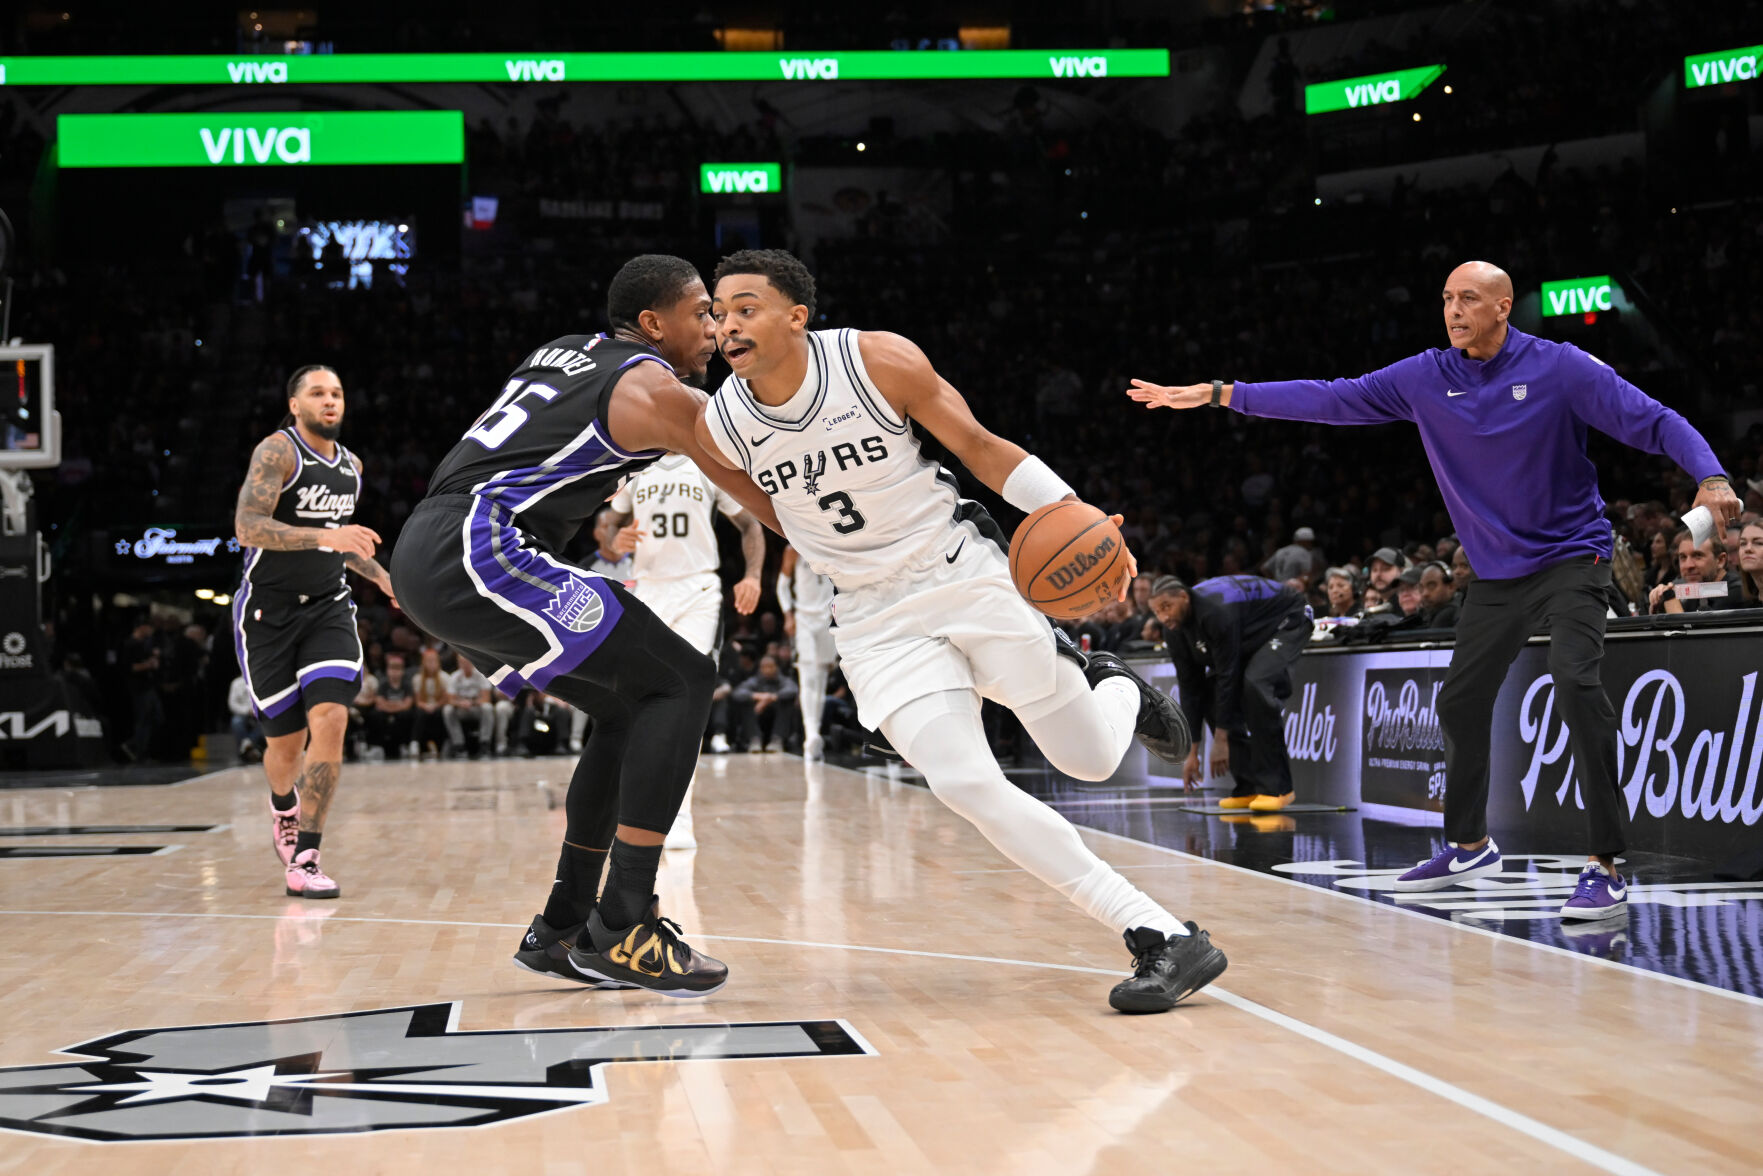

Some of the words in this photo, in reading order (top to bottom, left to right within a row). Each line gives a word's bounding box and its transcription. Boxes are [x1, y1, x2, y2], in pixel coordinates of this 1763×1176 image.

[227, 61, 288, 83] viva
[505, 60, 566, 82] viva
[779, 58, 839, 80] viva
[1049, 56, 1108, 78] viva
[1691, 55, 1757, 86] viva
[1344, 79, 1400, 108] viva
[199, 126, 311, 164] viva
[707, 170, 768, 193] viva
[461, 377, 562, 450] 15
[828, 410, 856, 427] LEDGER
[757, 435, 889, 496] SPURS
[296, 484, 356, 520] Kings
[636, 482, 704, 505] SPURS
[651, 512, 689, 539] 30
[816, 490, 867, 537] 3
[1045, 535, 1116, 591] Wilson
[556, 584, 584, 619] SACRAMENTO
[561, 587, 596, 628] KINGS
